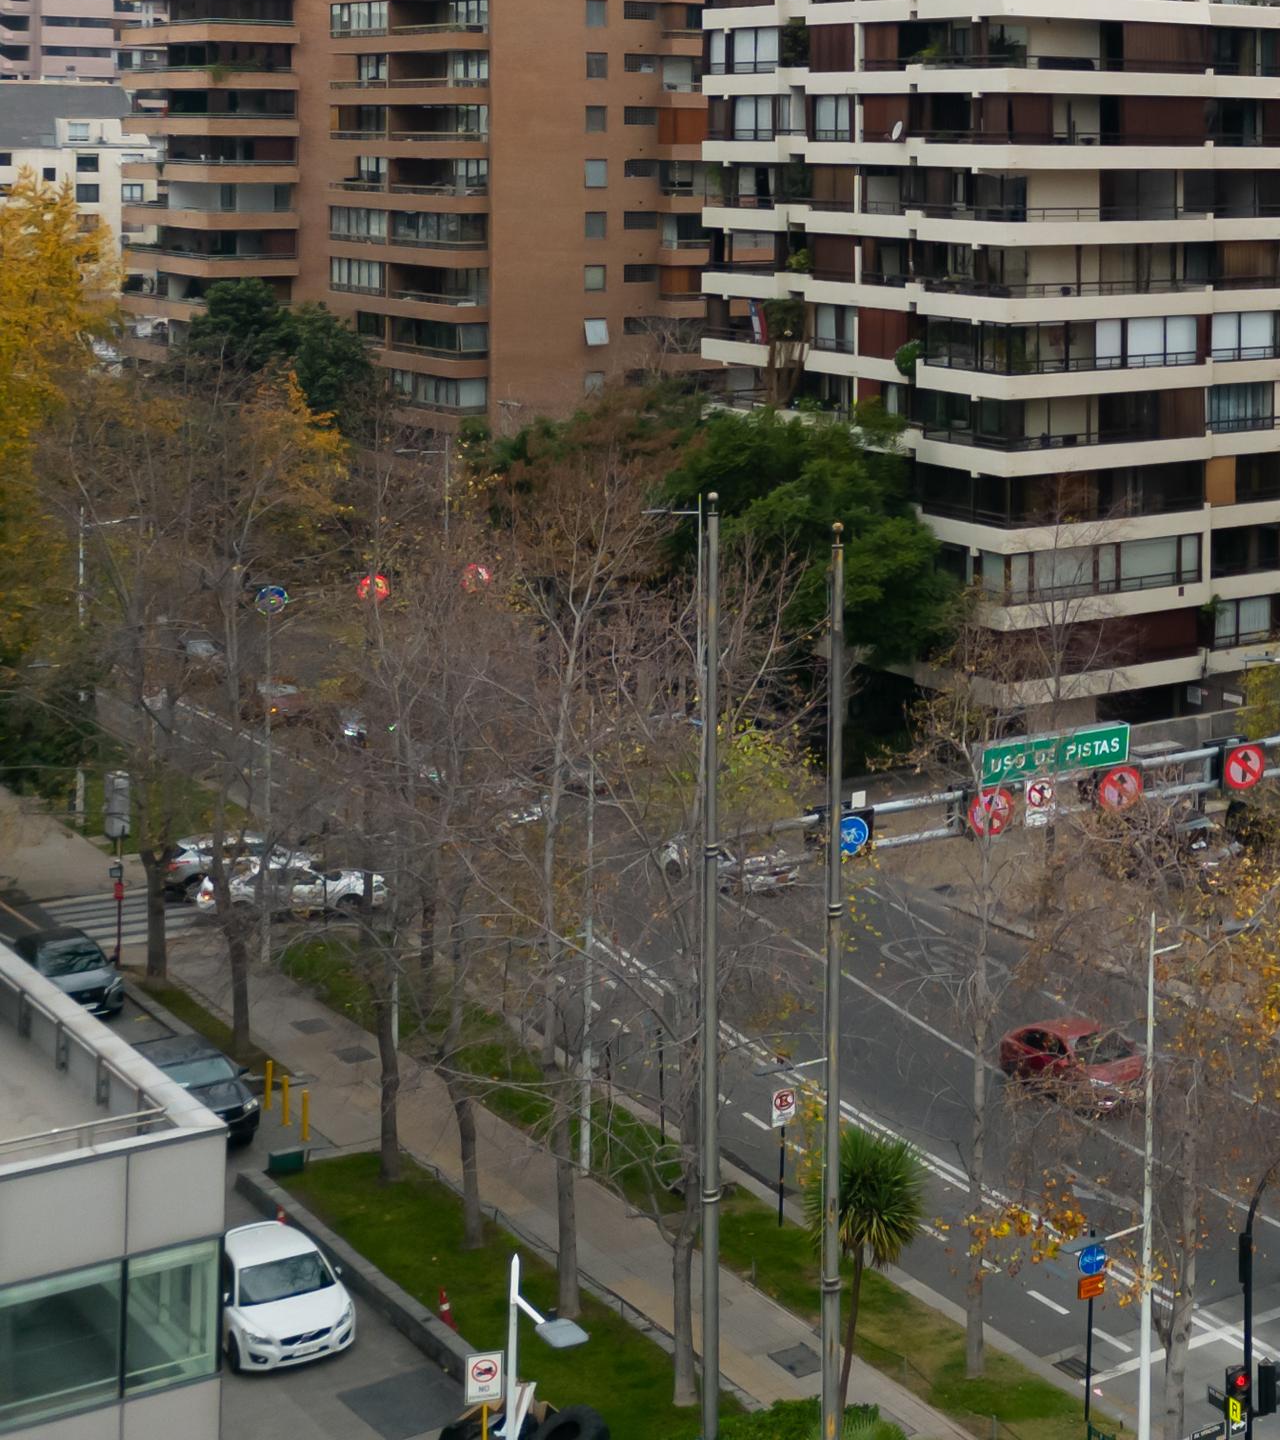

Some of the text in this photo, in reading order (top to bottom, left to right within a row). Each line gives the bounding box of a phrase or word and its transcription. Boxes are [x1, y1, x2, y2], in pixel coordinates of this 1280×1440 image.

[991, 737, 1120, 774] USO DE PISTAS
